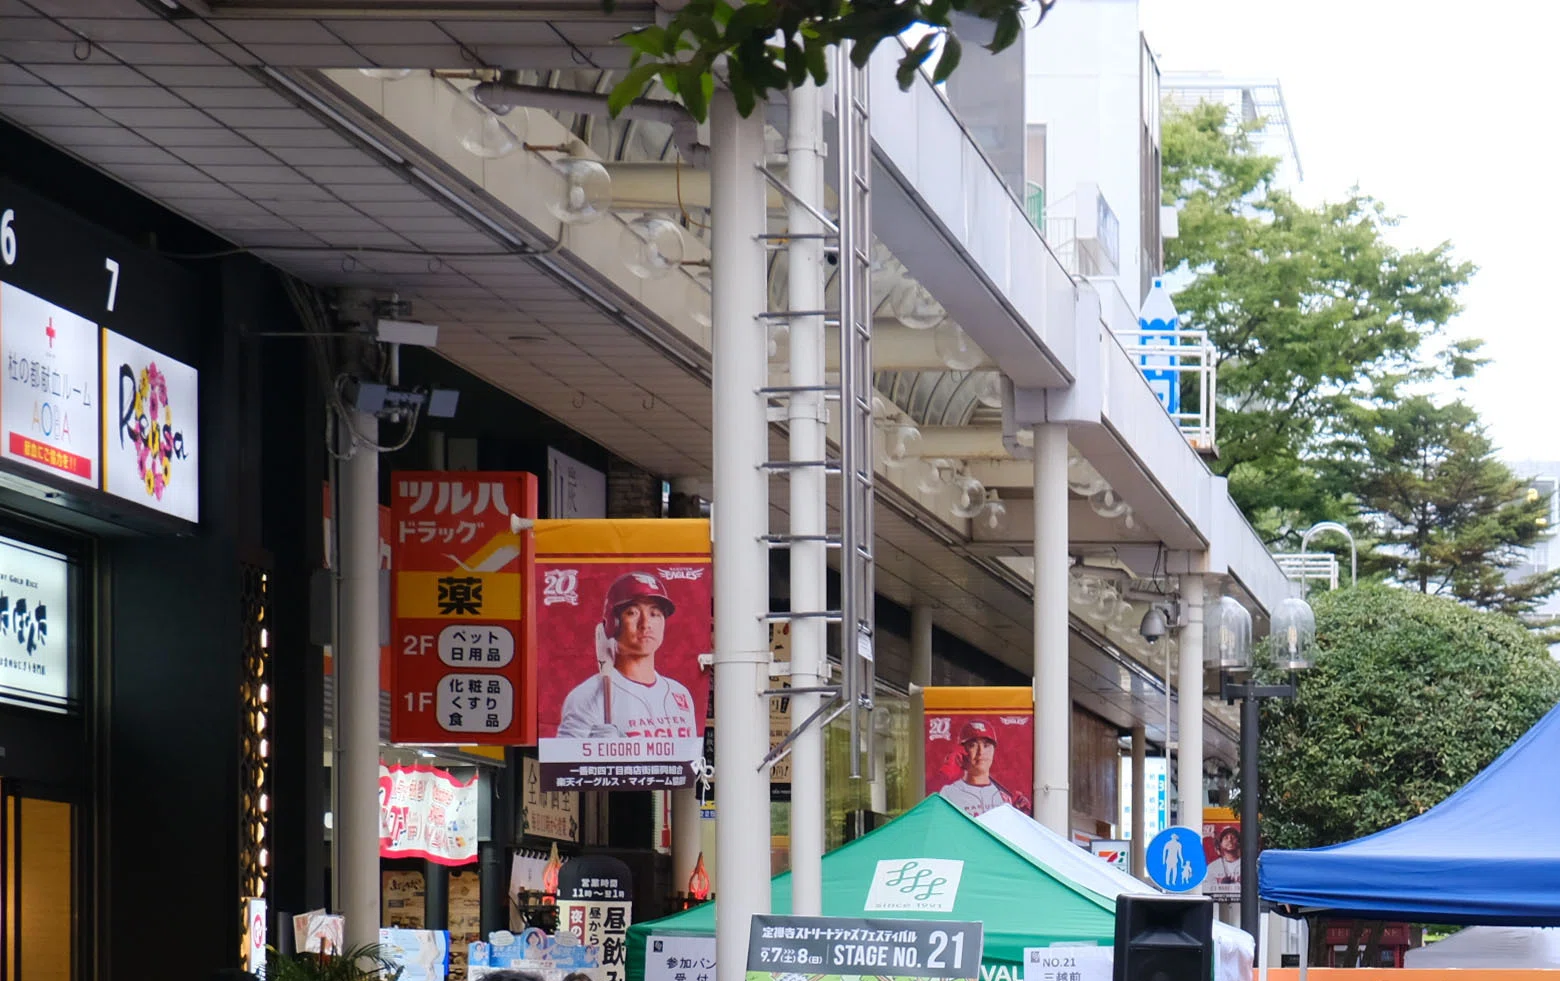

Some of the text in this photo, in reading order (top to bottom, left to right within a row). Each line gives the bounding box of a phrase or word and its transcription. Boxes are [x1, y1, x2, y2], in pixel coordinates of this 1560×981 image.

[1, 209, 17, 265] 6
[105, 257, 120, 312] 7
[31, 400, 72, 444] AOBA
[399, 481, 509, 516] ツルハ
[399, 520, 485, 544] ドラッグ
[544, 574, 577, 596] 20
[438, 576, 482, 615] 薬
[403, 635, 434, 656] 2F
[452, 631, 499, 644] ペット
[451, 648, 501, 662] 日用品
[449, 679, 501, 694] 化粧品
[403, 693, 433, 713] 1F
[451, 696, 497, 711] くすり
[629, 716, 686, 727] RAKUTEN
[582, 742, 675, 757] 5 EIGORO MOGI
[581, 878, 618, 888] 営業時間
[588, 906, 601, 946] 昼から
[761, 926, 918, 944] 定禅寺ストリートジャズフェスティバル
[833, 930, 966, 969] STAGE NO. 21
[1043, 958, 1076, 968] NO.21
